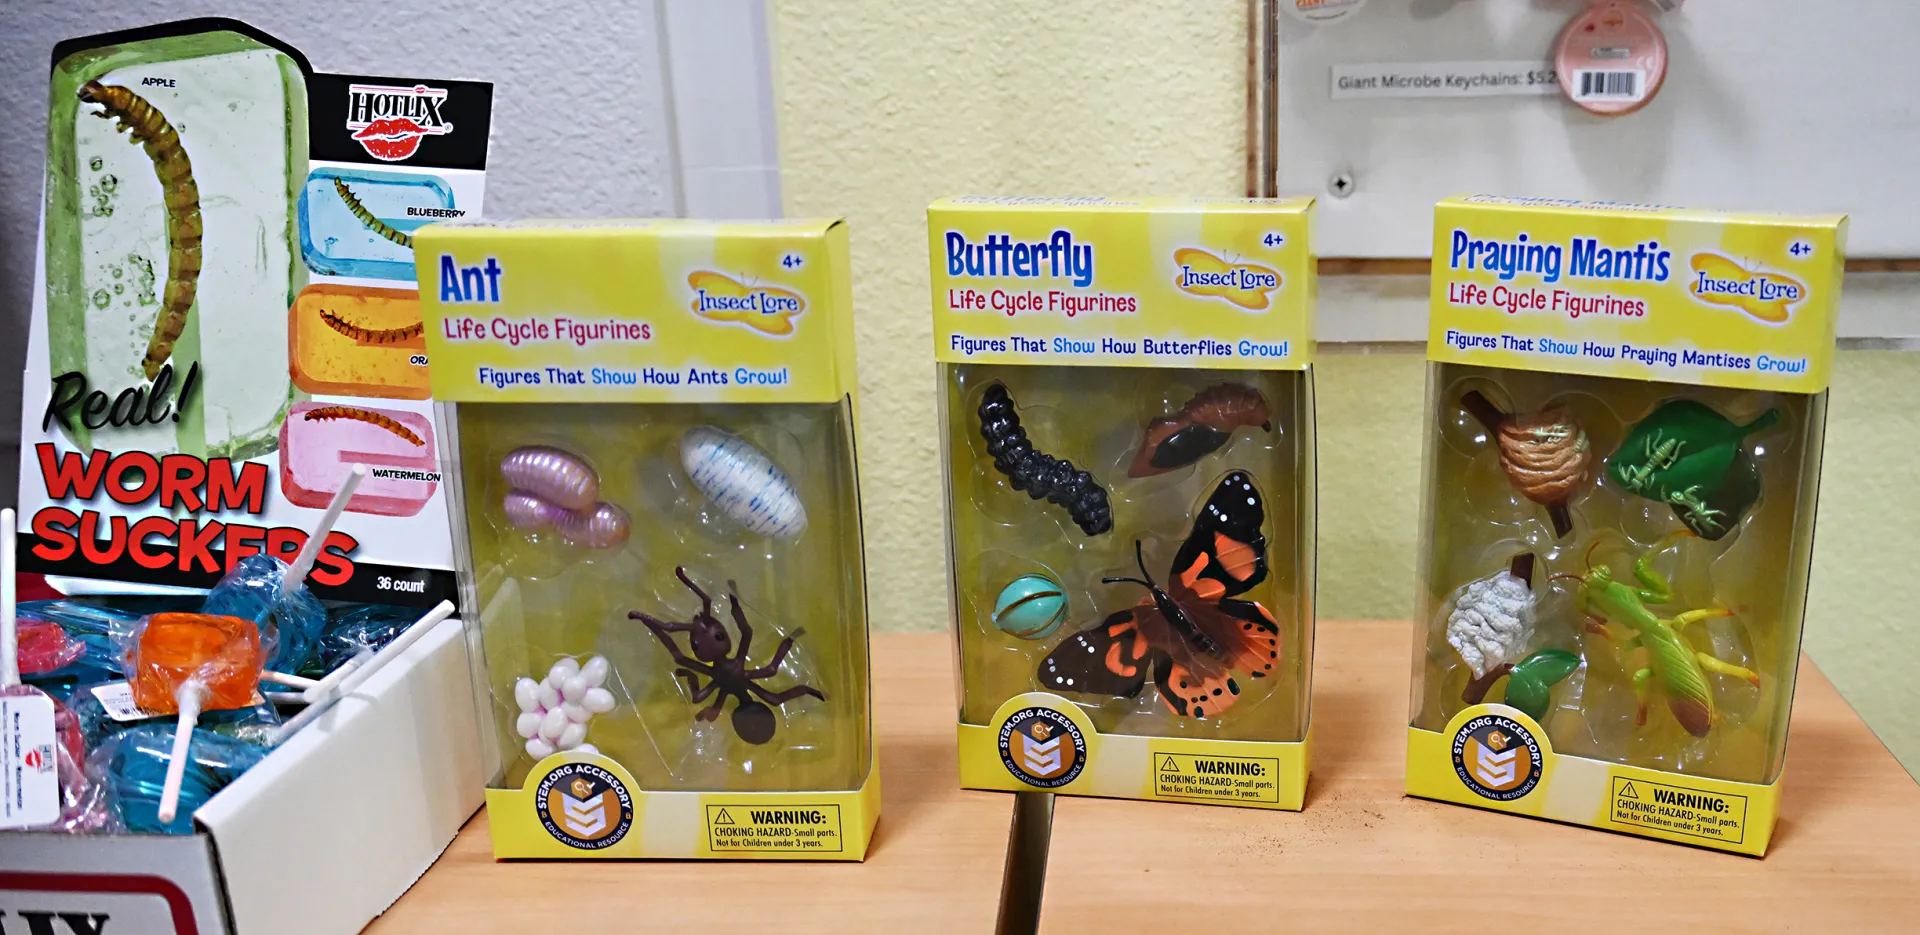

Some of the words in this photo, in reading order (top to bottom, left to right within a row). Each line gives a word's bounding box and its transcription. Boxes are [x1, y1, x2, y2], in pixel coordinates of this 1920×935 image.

[141, 76, 176, 88] APPLE
[1338, 76, 1377, 89] Giant
[1381, 74, 1441, 88] Microbe
[1445, 73, 1523, 91] Keychains:
[1527, 70, 1557, 85] $5.2
[349, 92, 446, 127] HOTLIX
[407, 207, 466, 218] BLUEBERRY
[1263, 233, 1284, 247] 4+
[1789, 242, 1812, 257] 4+
[782, 254, 803, 269] 4+
[945, 230, 1093, 288] Butterfly
[1451, 230, 1562, 283] Praying
[1569, 238, 1670, 282] Mantis
[440, 255, 502, 303] Ant
[1182, 266, 1237, 287] Insect
[1239, 267, 1276, 290] Lore
[1696, 271, 1756, 296] Insect
[1758, 276, 1799, 300] Lore
[699, 289, 758, 311] Insect
[759, 288, 798, 314] Lore
[949, 290, 986, 310] Life
[990, 290, 1043, 317] Cycle
[1048, 291, 1137, 317] Figurines
[1449, 282, 1487, 306] Life
[1492, 286, 1547, 314] Cycle
[1552, 290, 1645, 318] Figurines
[444, 318, 486, 340] Life
[491, 318, 550, 346] Cycle
[555, 318, 651, 346] Figurines
[951, 335, 1006, 354] Figures
[1011, 336, 1047, 353] That
[1053, 337, 1095, 354] Show
[1101, 338, 1137, 354] How
[1143, 339, 1232, 356] Butterflies
[1238, 340, 1288, 357] Grow!
[1446, 331, 1497, 351] Figures
[1501, 335, 1534, 352] That
[1539, 337, 1578, 355] Show
[1583, 341, 1615, 358] How
[1621, 345, 1677, 367] Praying
[1682, 349, 1751, 369] Mantises
[1756, 355, 1806, 374] Grow!
[479, 367, 541, 388] Figures
[545, 367, 586, 385] That
[591, 367, 637, 385] Show
[643, 367, 681, 385] How
[687, 367, 728, 385] Ants
[735, 367, 789, 385] Grow!
[42, 360, 199, 433] Real!
[34, 442, 268, 514] WORM
[372, 468, 441, 482] WATERMELON
[31, 506, 359, 586] SUCKERS
[377, 576, 392, 590] 36
[393, 577, 426, 593] count
[1000, 709, 1034, 749] STEM.ORG
[1036, 708, 1085, 753] ACCESSORY
[1454, 717, 1492, 755] STEM.ORG
[1494, 717, 1541, 767] ACCESSORY
[1005, 759, 1051, 787] EDUCATIONAL
[1051, 764, 1082, 787] RESOURCE
[1160, 773, 1197, 785] CHOKING
[1199, 776, 1254, 788] HAZARD-Small
[1255, 780, 1275, 789] parts.
[1195, 760, 1266, 776] WARNING:
[537, 765, 573, 809] STEM.ORG
[575, 764, 631, 809] ACCESSORY
[1161, 784, 1173, 792] Not
[1174, 785, 1184, 793] for
[1185, 785, 1213, 795] Children
[1214, 788, 1233, 796] under
[1241, 790, 1261, 798] years.
[1457, 766, 1501, 799] EDUCATIONAL
[1502, 779, 1536, 799] RESOURCE
[1617, 798, 1656, 814] CHOKING
[1658, 806, 1717, 824] HAZARD-Small
[1719, 818, 1740, 829] parts.
[1653, 788, 1730, 813] WARNING:
[750, 810, 827, 824] WARNING:
[1616, 810, 1629, 819] Not
[1630, 812, 1641, 821] for
[1642, 814, 1672, 827] Children
[1673, 820, 1694, 831] under
[1695, 824, 1701, 832] 3
[1702, 826, 1724, 836] years.
[544, 821, 596, 849] EDUCATIONAL
[597, 822, 629, 848] RESOURCE
[714, 827, 754, 837] CHOKING
[756, 827, 815, 837] HAZARD-Small
[817, 829, 838, 838] parts.
[716, 839, 729, 847] Not
[730, 838, 740, 847] for
[742, 838, 772, 847] Children
[773, 839, 794, 847] under
[795, 839, 801, 847] 3
[802, 840, 823, 848] years.
